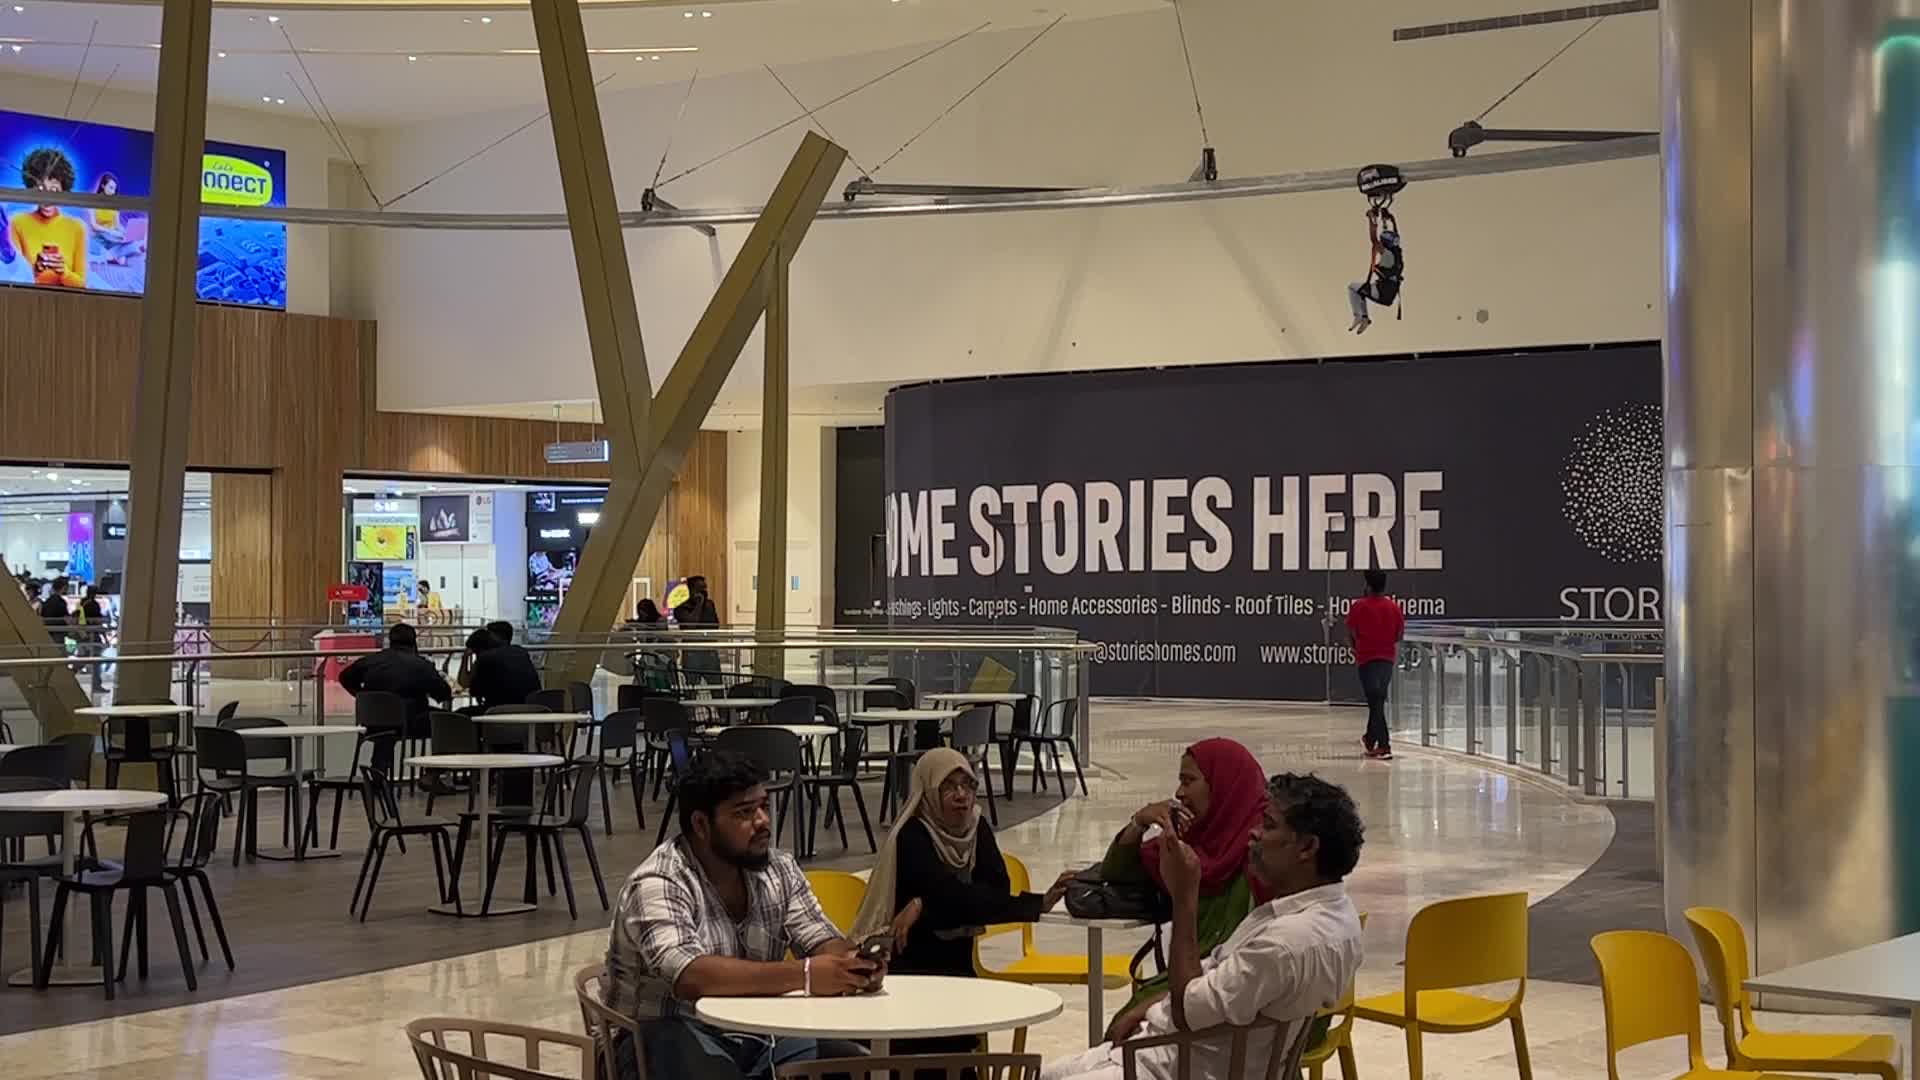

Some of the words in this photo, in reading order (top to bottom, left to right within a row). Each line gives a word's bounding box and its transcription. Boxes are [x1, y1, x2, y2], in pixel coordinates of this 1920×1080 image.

[886, 488, 958, 577] OME
[969, 476, 1233, 576] STORIES
[1253, 471, 1443, 571] HERE
[928, 598, 960, 619] Lights
[969, 597, 1017, 619] Carpets
[1029, 598, 1068, 615] Home
[1071, 595, 1158, 615] Accessories
[1172, 595, 1221, 614] Blinds
[1235, 595, 1273, 615] Roof
[1274, 595, 1313, 615] Tiles
[1329, 596, 1357, 615] Ho
[1384, 595, 1445, 615] inema
[1089, 641, 1237, 664] @storieshomes.com
[1260, 642, 1356, 665] www.stories
